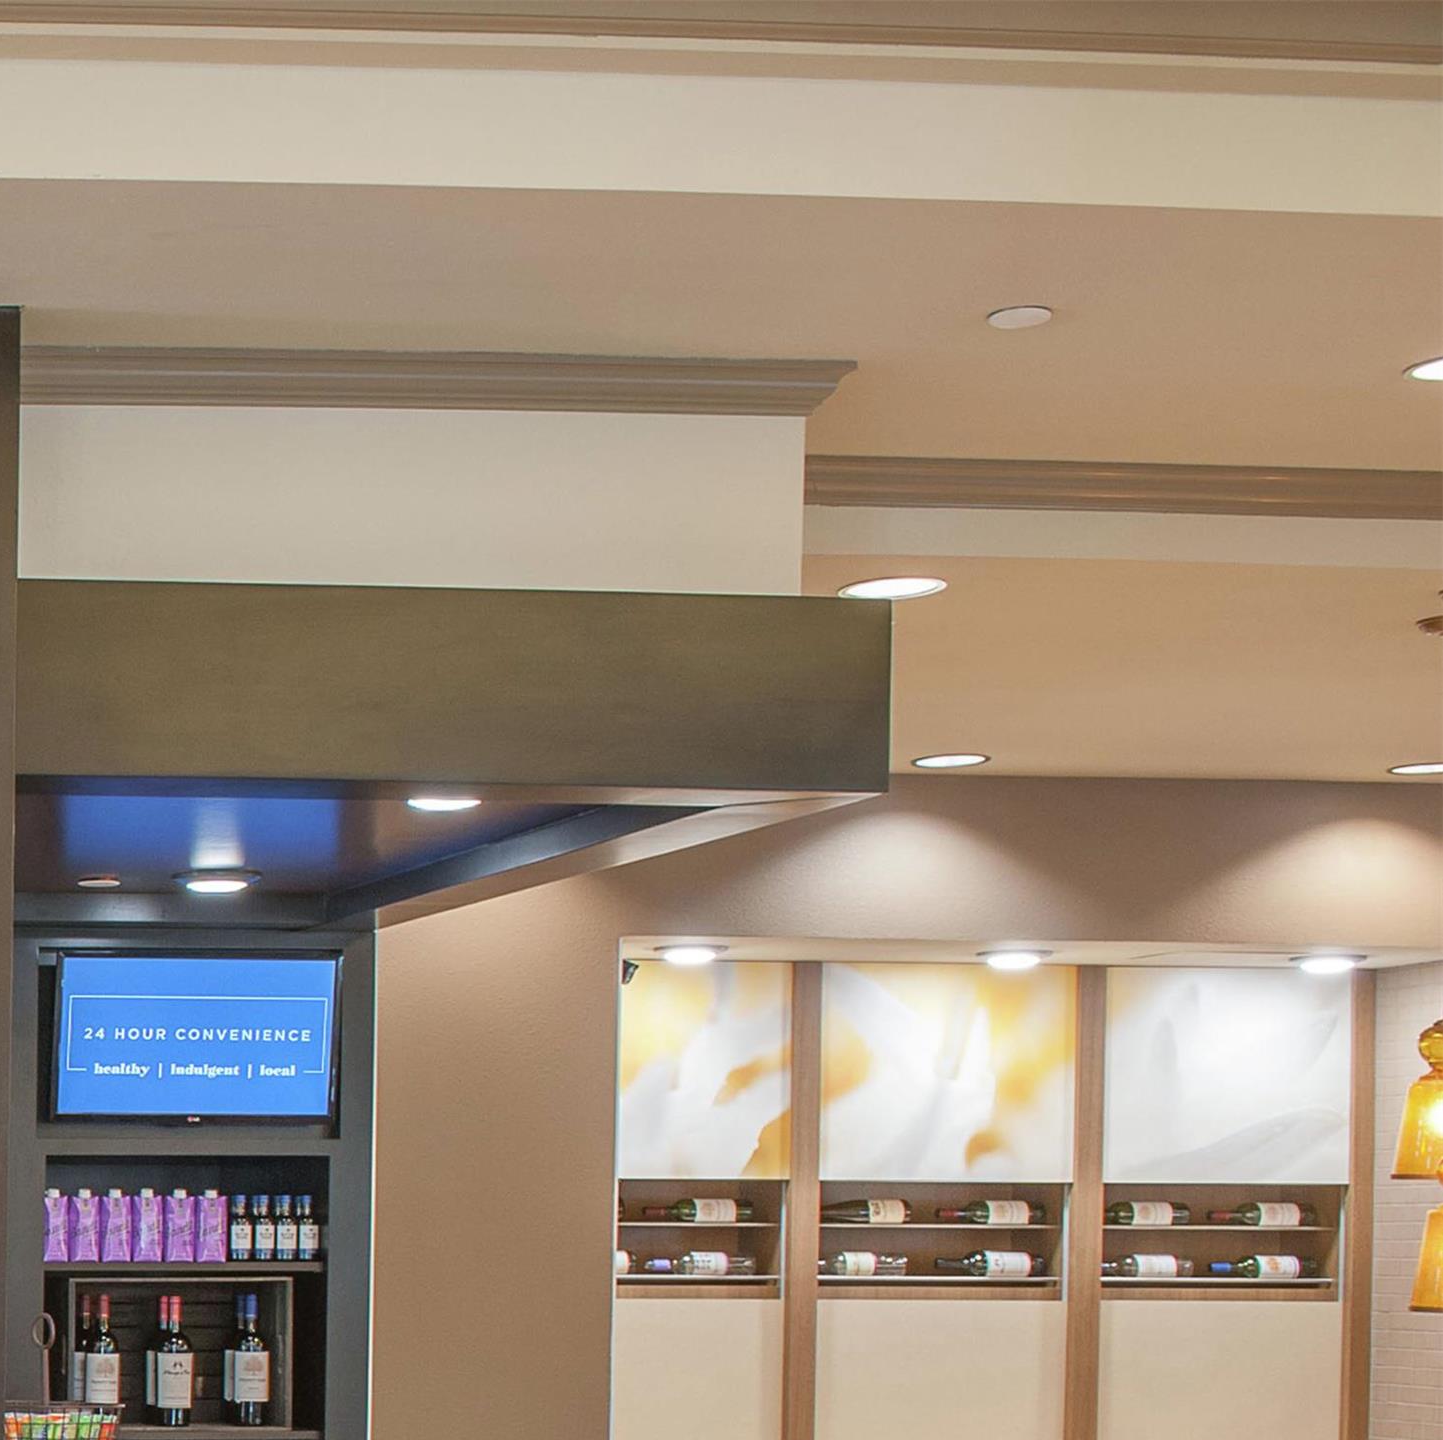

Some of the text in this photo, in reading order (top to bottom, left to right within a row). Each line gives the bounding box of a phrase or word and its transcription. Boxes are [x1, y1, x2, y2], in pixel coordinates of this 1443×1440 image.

[83, 1027, 312, 1043] 24 HOUR CONVENIENCE
[93, 1062, 150, 1077] healthy
[259, 1065, 296, 1077] local
